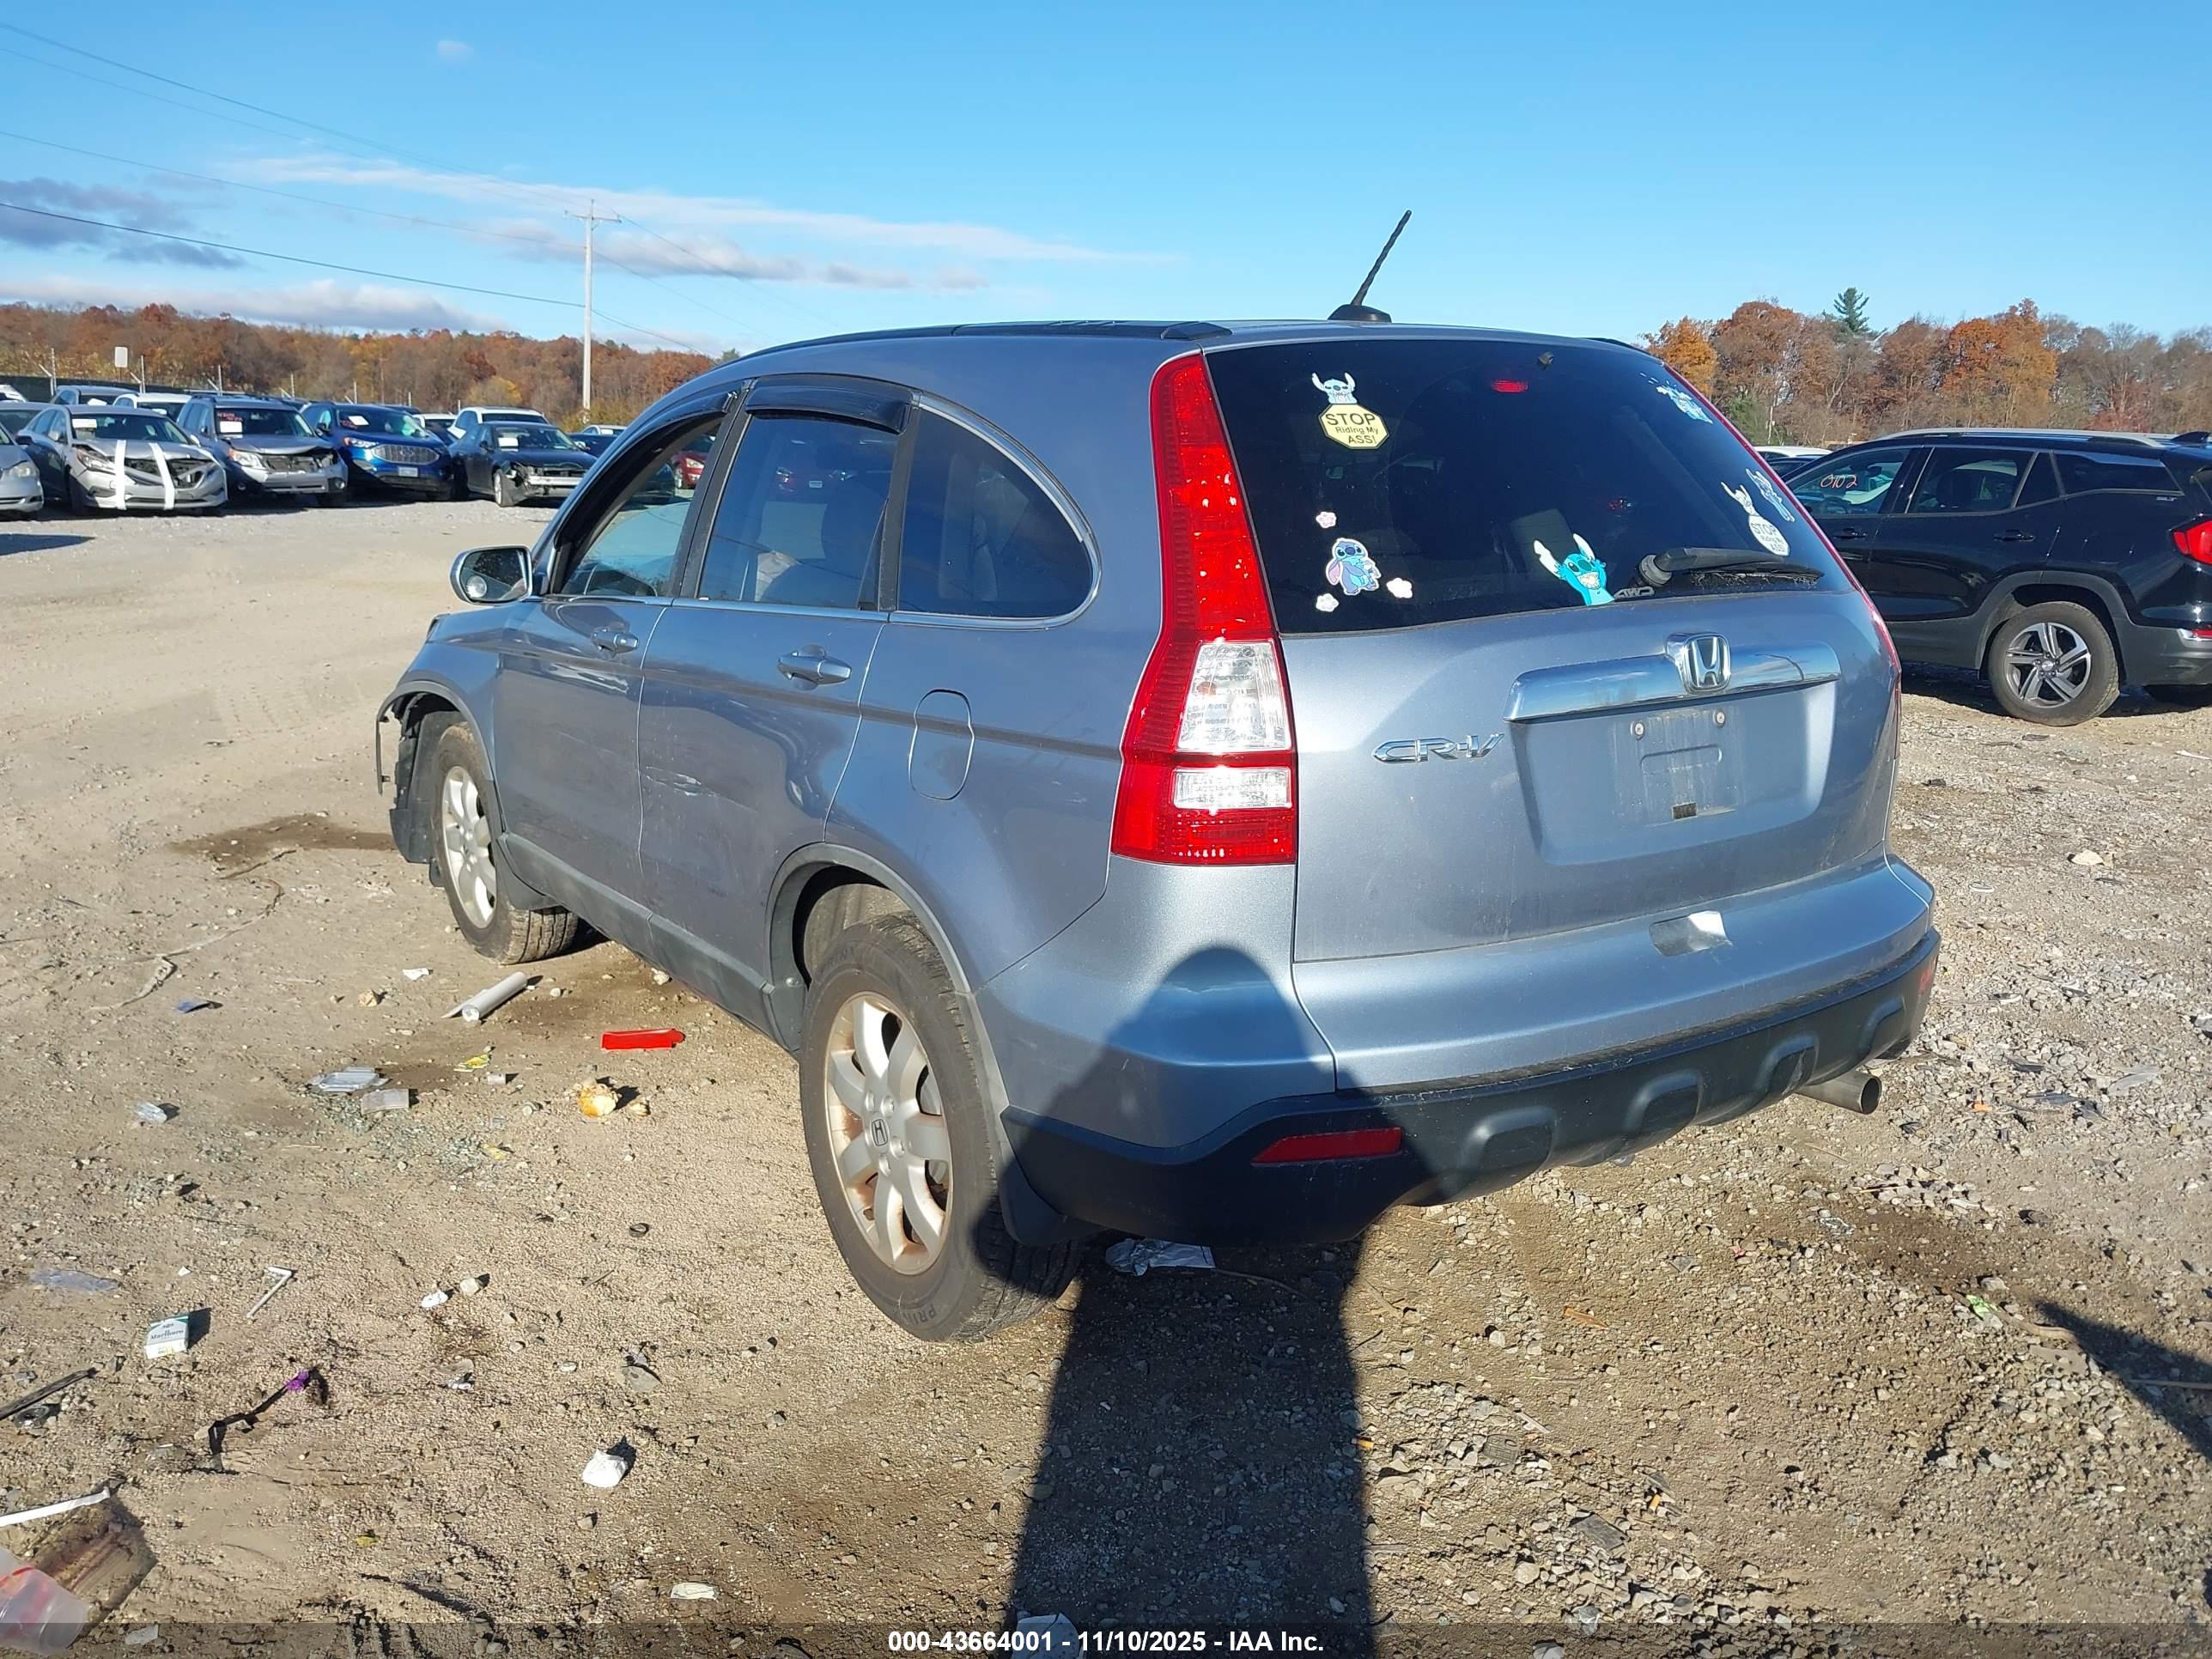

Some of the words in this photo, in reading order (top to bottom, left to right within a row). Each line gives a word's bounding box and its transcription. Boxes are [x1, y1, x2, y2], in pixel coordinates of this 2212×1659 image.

[1325, 413, 1376, 426] STOP
[1335, 427, 1365, 435] Riding
[1366, 427, 1378, 435] My
[1371, 732, 1505, 764] CR-V
